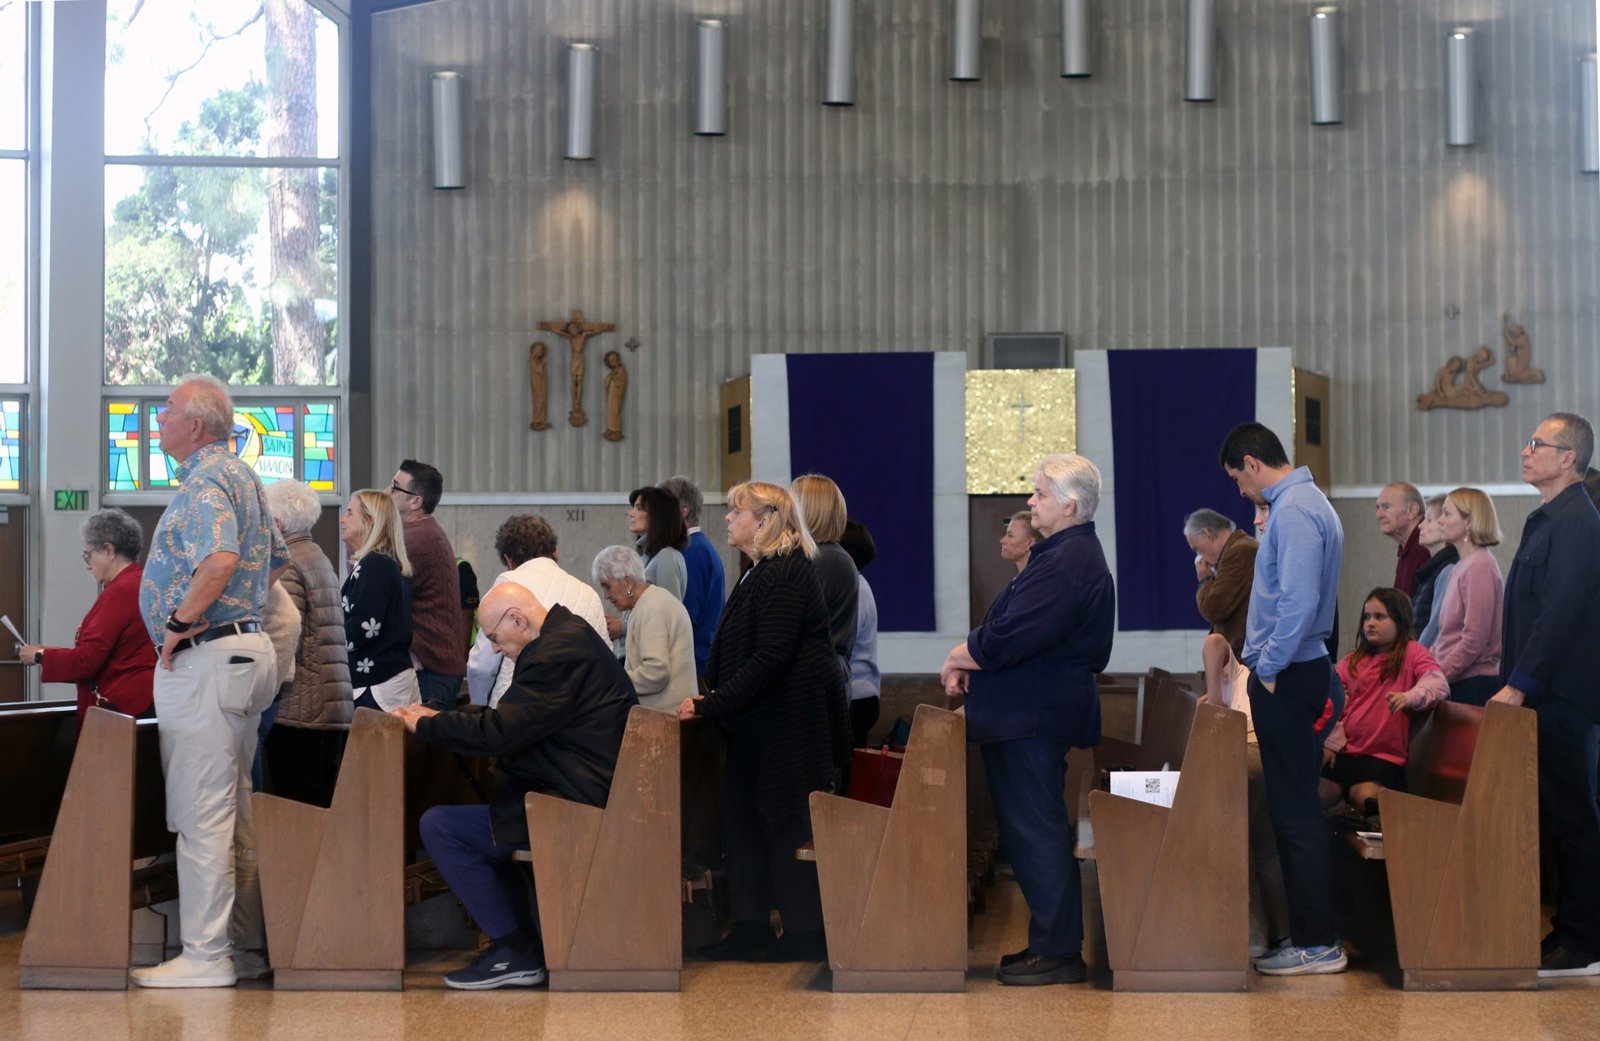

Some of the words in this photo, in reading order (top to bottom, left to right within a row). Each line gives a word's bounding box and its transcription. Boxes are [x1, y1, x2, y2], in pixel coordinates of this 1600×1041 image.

[264, 438, 292, 454] SAINT
[259, 459, 293, 474] SIMON
[54, 490, 89, 511] EXIT
[566, 509, 585, 522] XII
